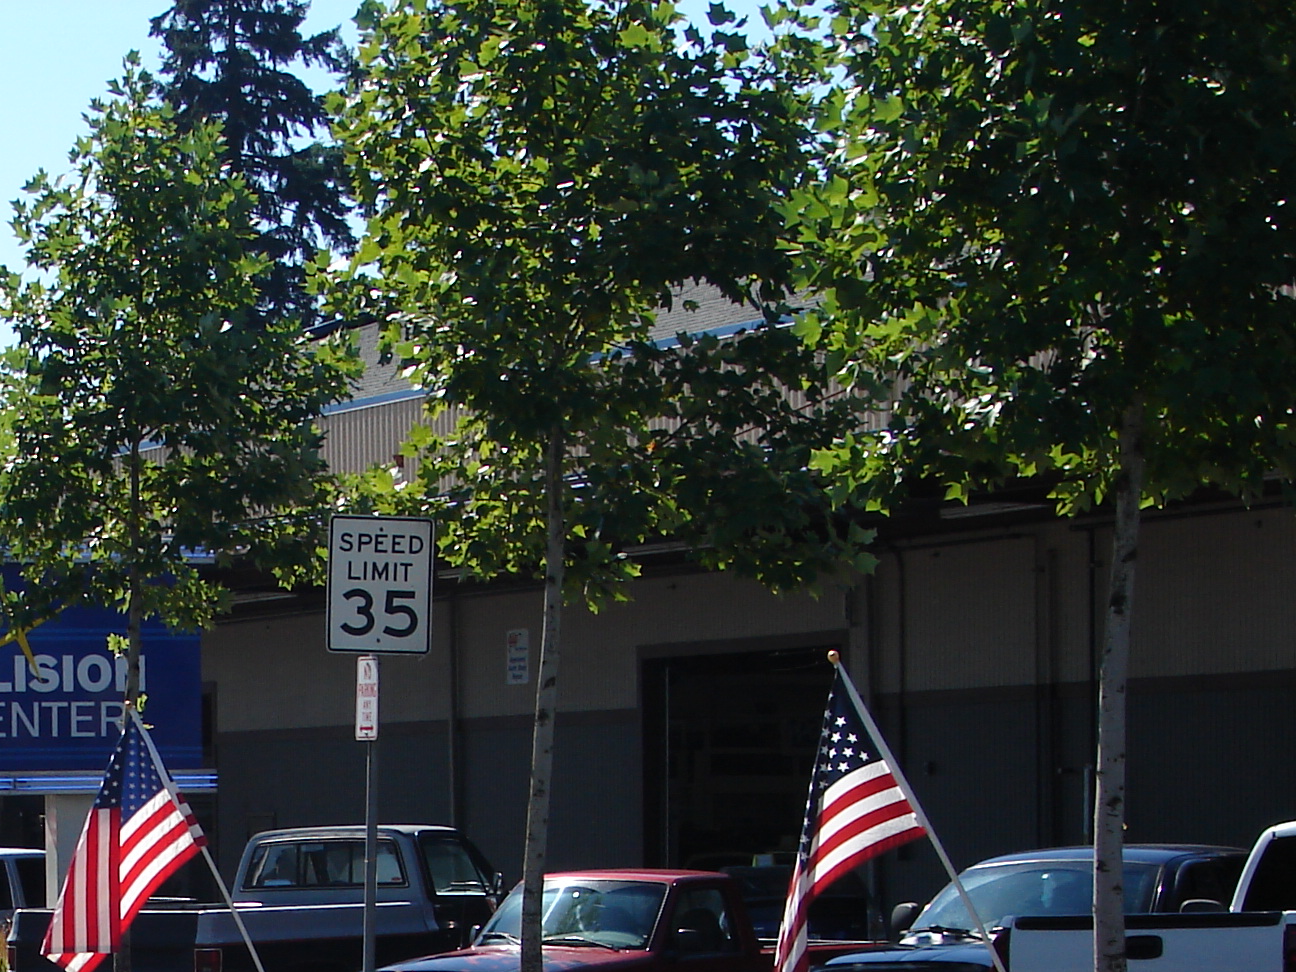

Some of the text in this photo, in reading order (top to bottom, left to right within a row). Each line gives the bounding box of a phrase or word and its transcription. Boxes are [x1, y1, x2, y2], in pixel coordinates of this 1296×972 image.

[339, 532, 425, 555] SPEED
[347, 561, 414, 582] LIMIT
[340, 588, 419, 638] 35
